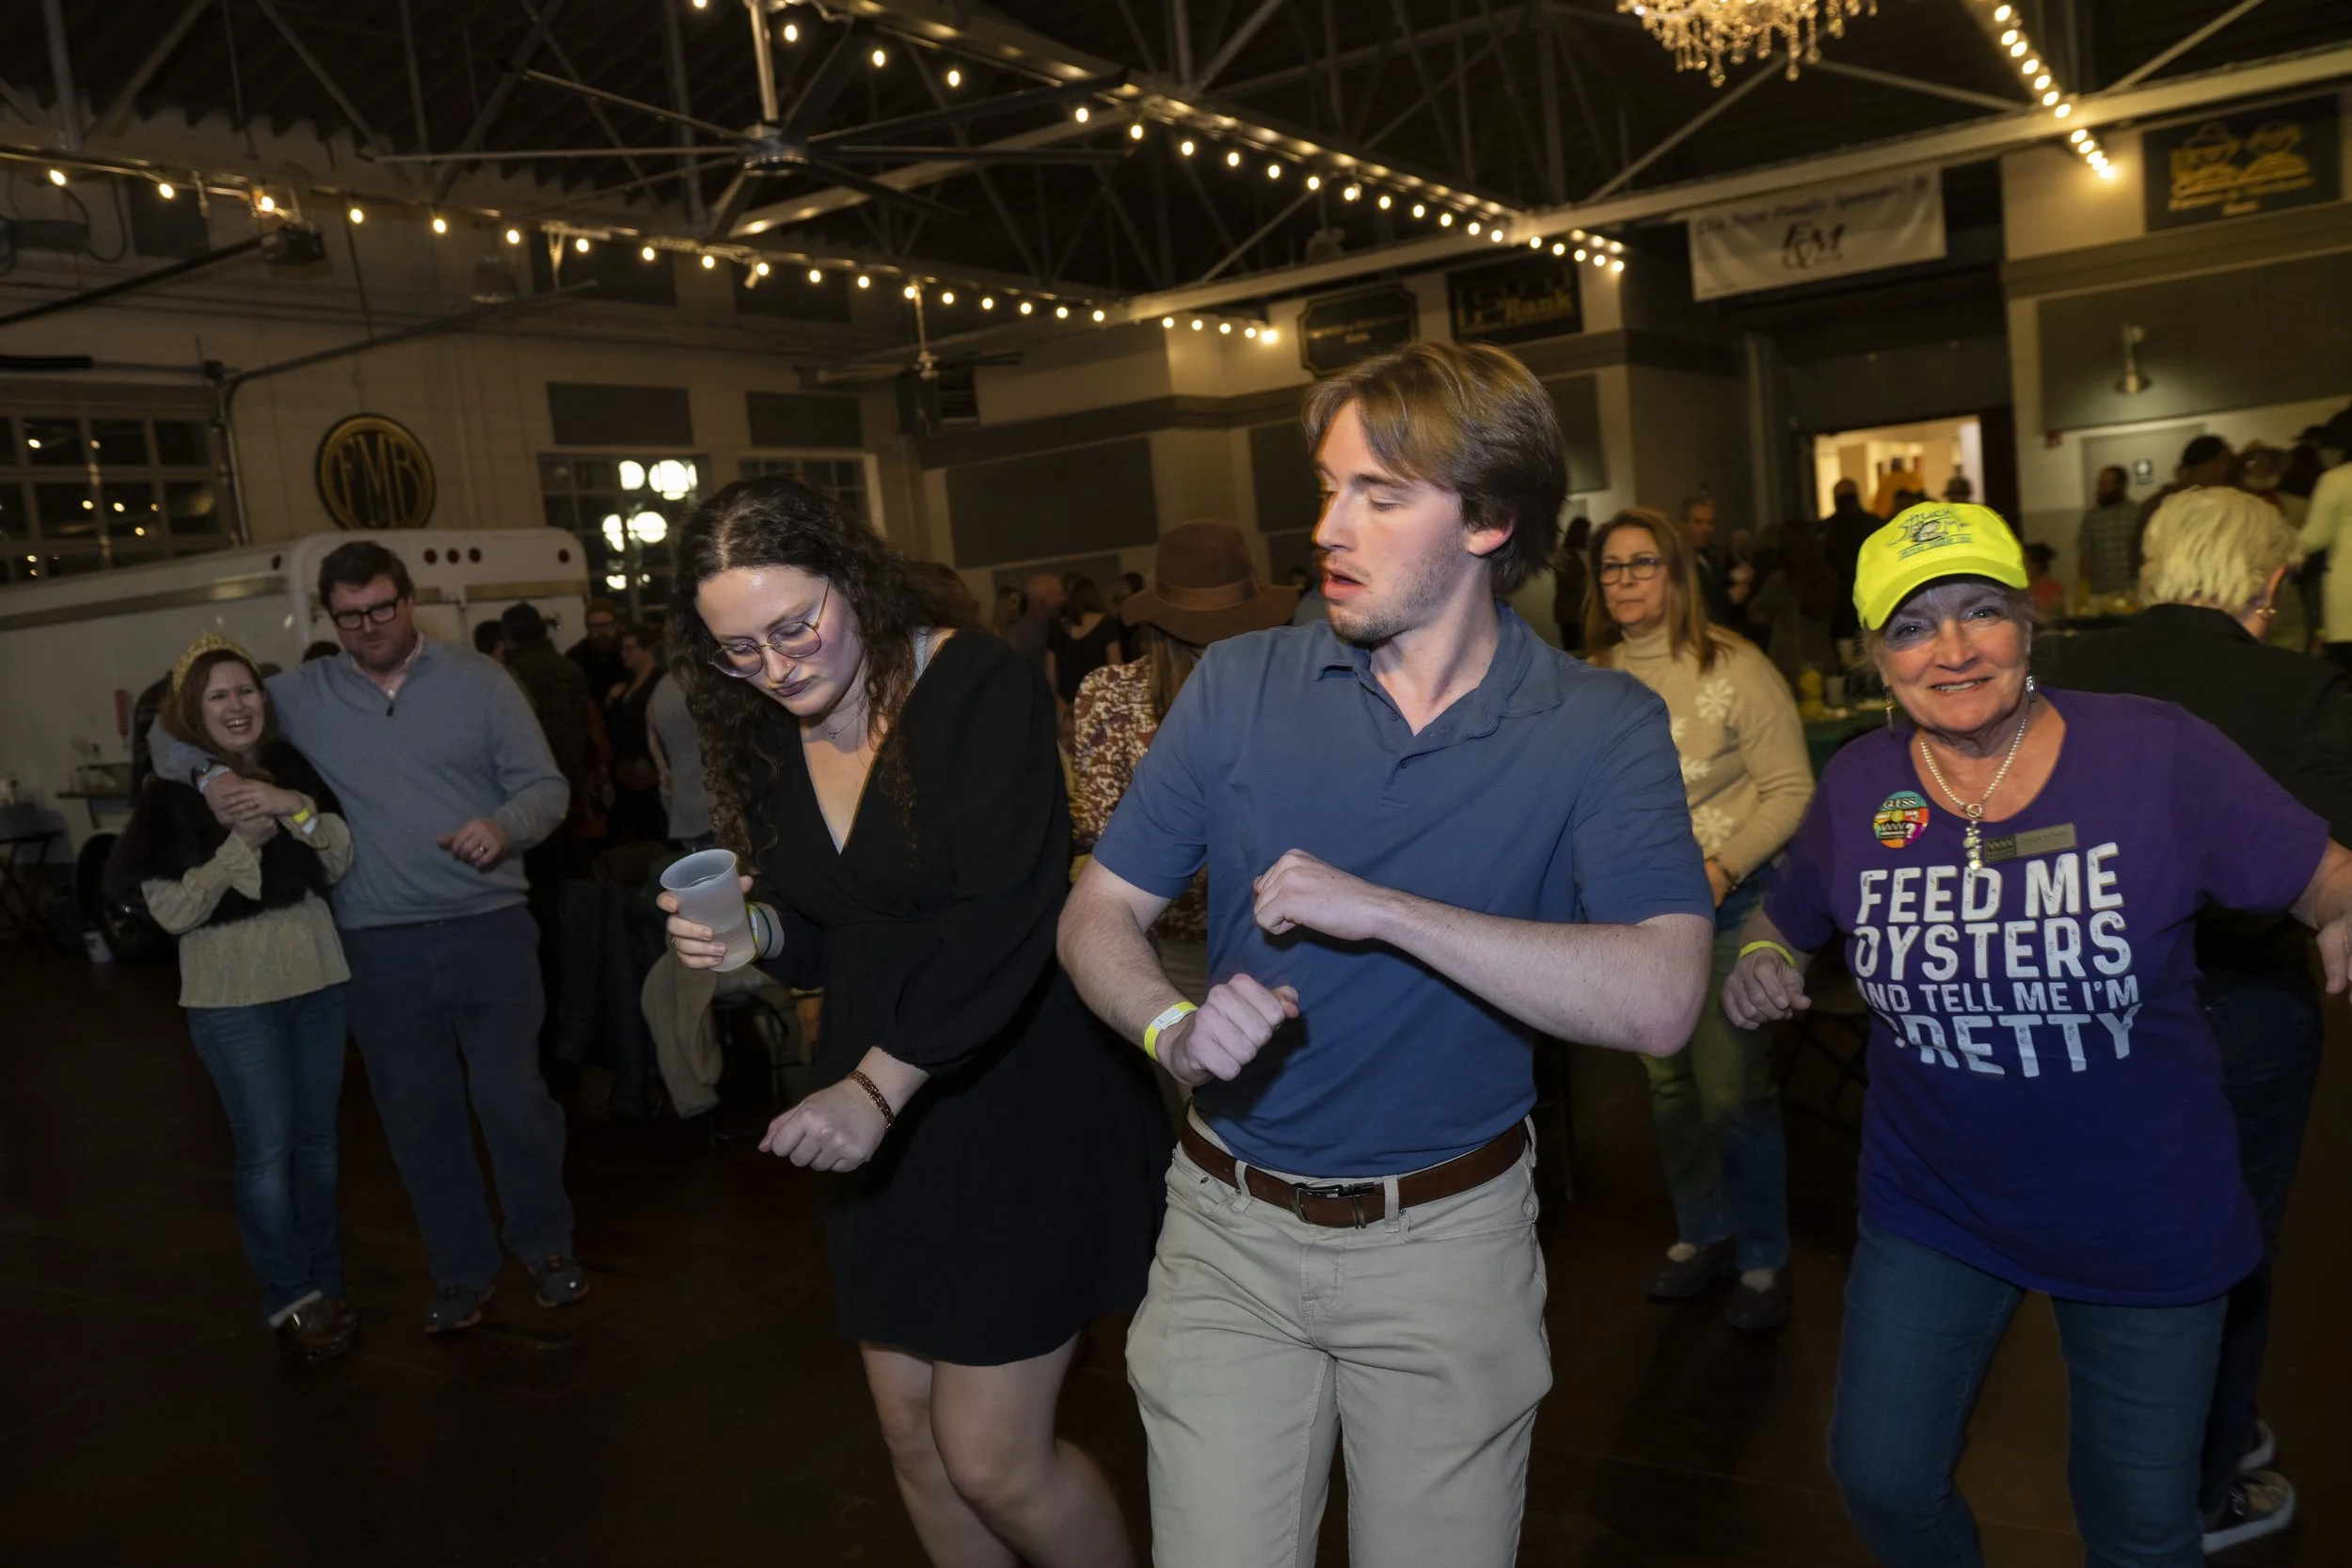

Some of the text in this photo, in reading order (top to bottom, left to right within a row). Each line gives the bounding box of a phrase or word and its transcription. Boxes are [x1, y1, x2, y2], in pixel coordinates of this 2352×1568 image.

[1856, 842, 2123, 924] FEED ME
[1854, 911, 2133, 981] OYSTERS
[1918, 982, 2003, 1012] TELL
[2013, 982, 2072, 1012] ME
[2082, 974, 2139, 1011] I'M
